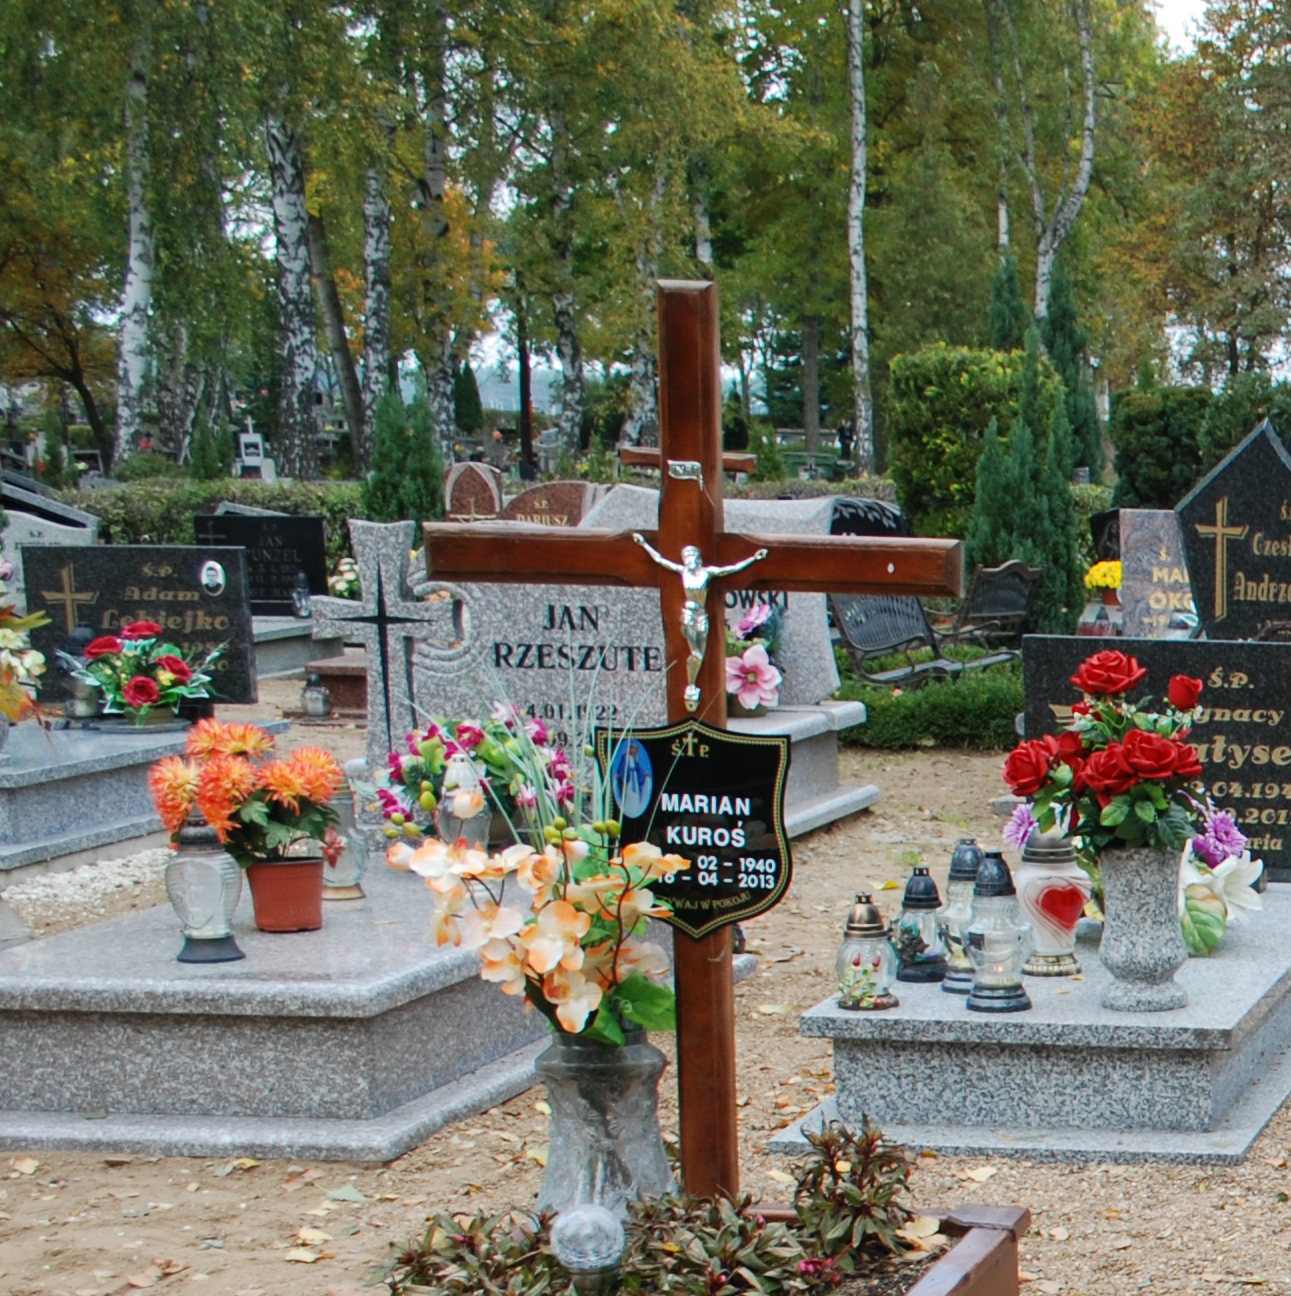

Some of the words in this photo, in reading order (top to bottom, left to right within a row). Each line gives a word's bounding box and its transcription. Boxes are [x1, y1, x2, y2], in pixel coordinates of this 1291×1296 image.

[123, 586, 200, 601] Adam
[543, 604, 600, 631] JAN
[1208, 666, 1255, 689] Ś.P.
[661, 793, 751, 816] MARIAN
[667, 820, 746, 848] KUROŚ
[697, 856, 718, 870] 02
[740, 858, 777, 874] 1940
[699, 871, 719, 886] 04
[738, 873, 776, 889] 2013
[701, 898, 710, 910] W
[713, 890, 752, 909] POKOJU
